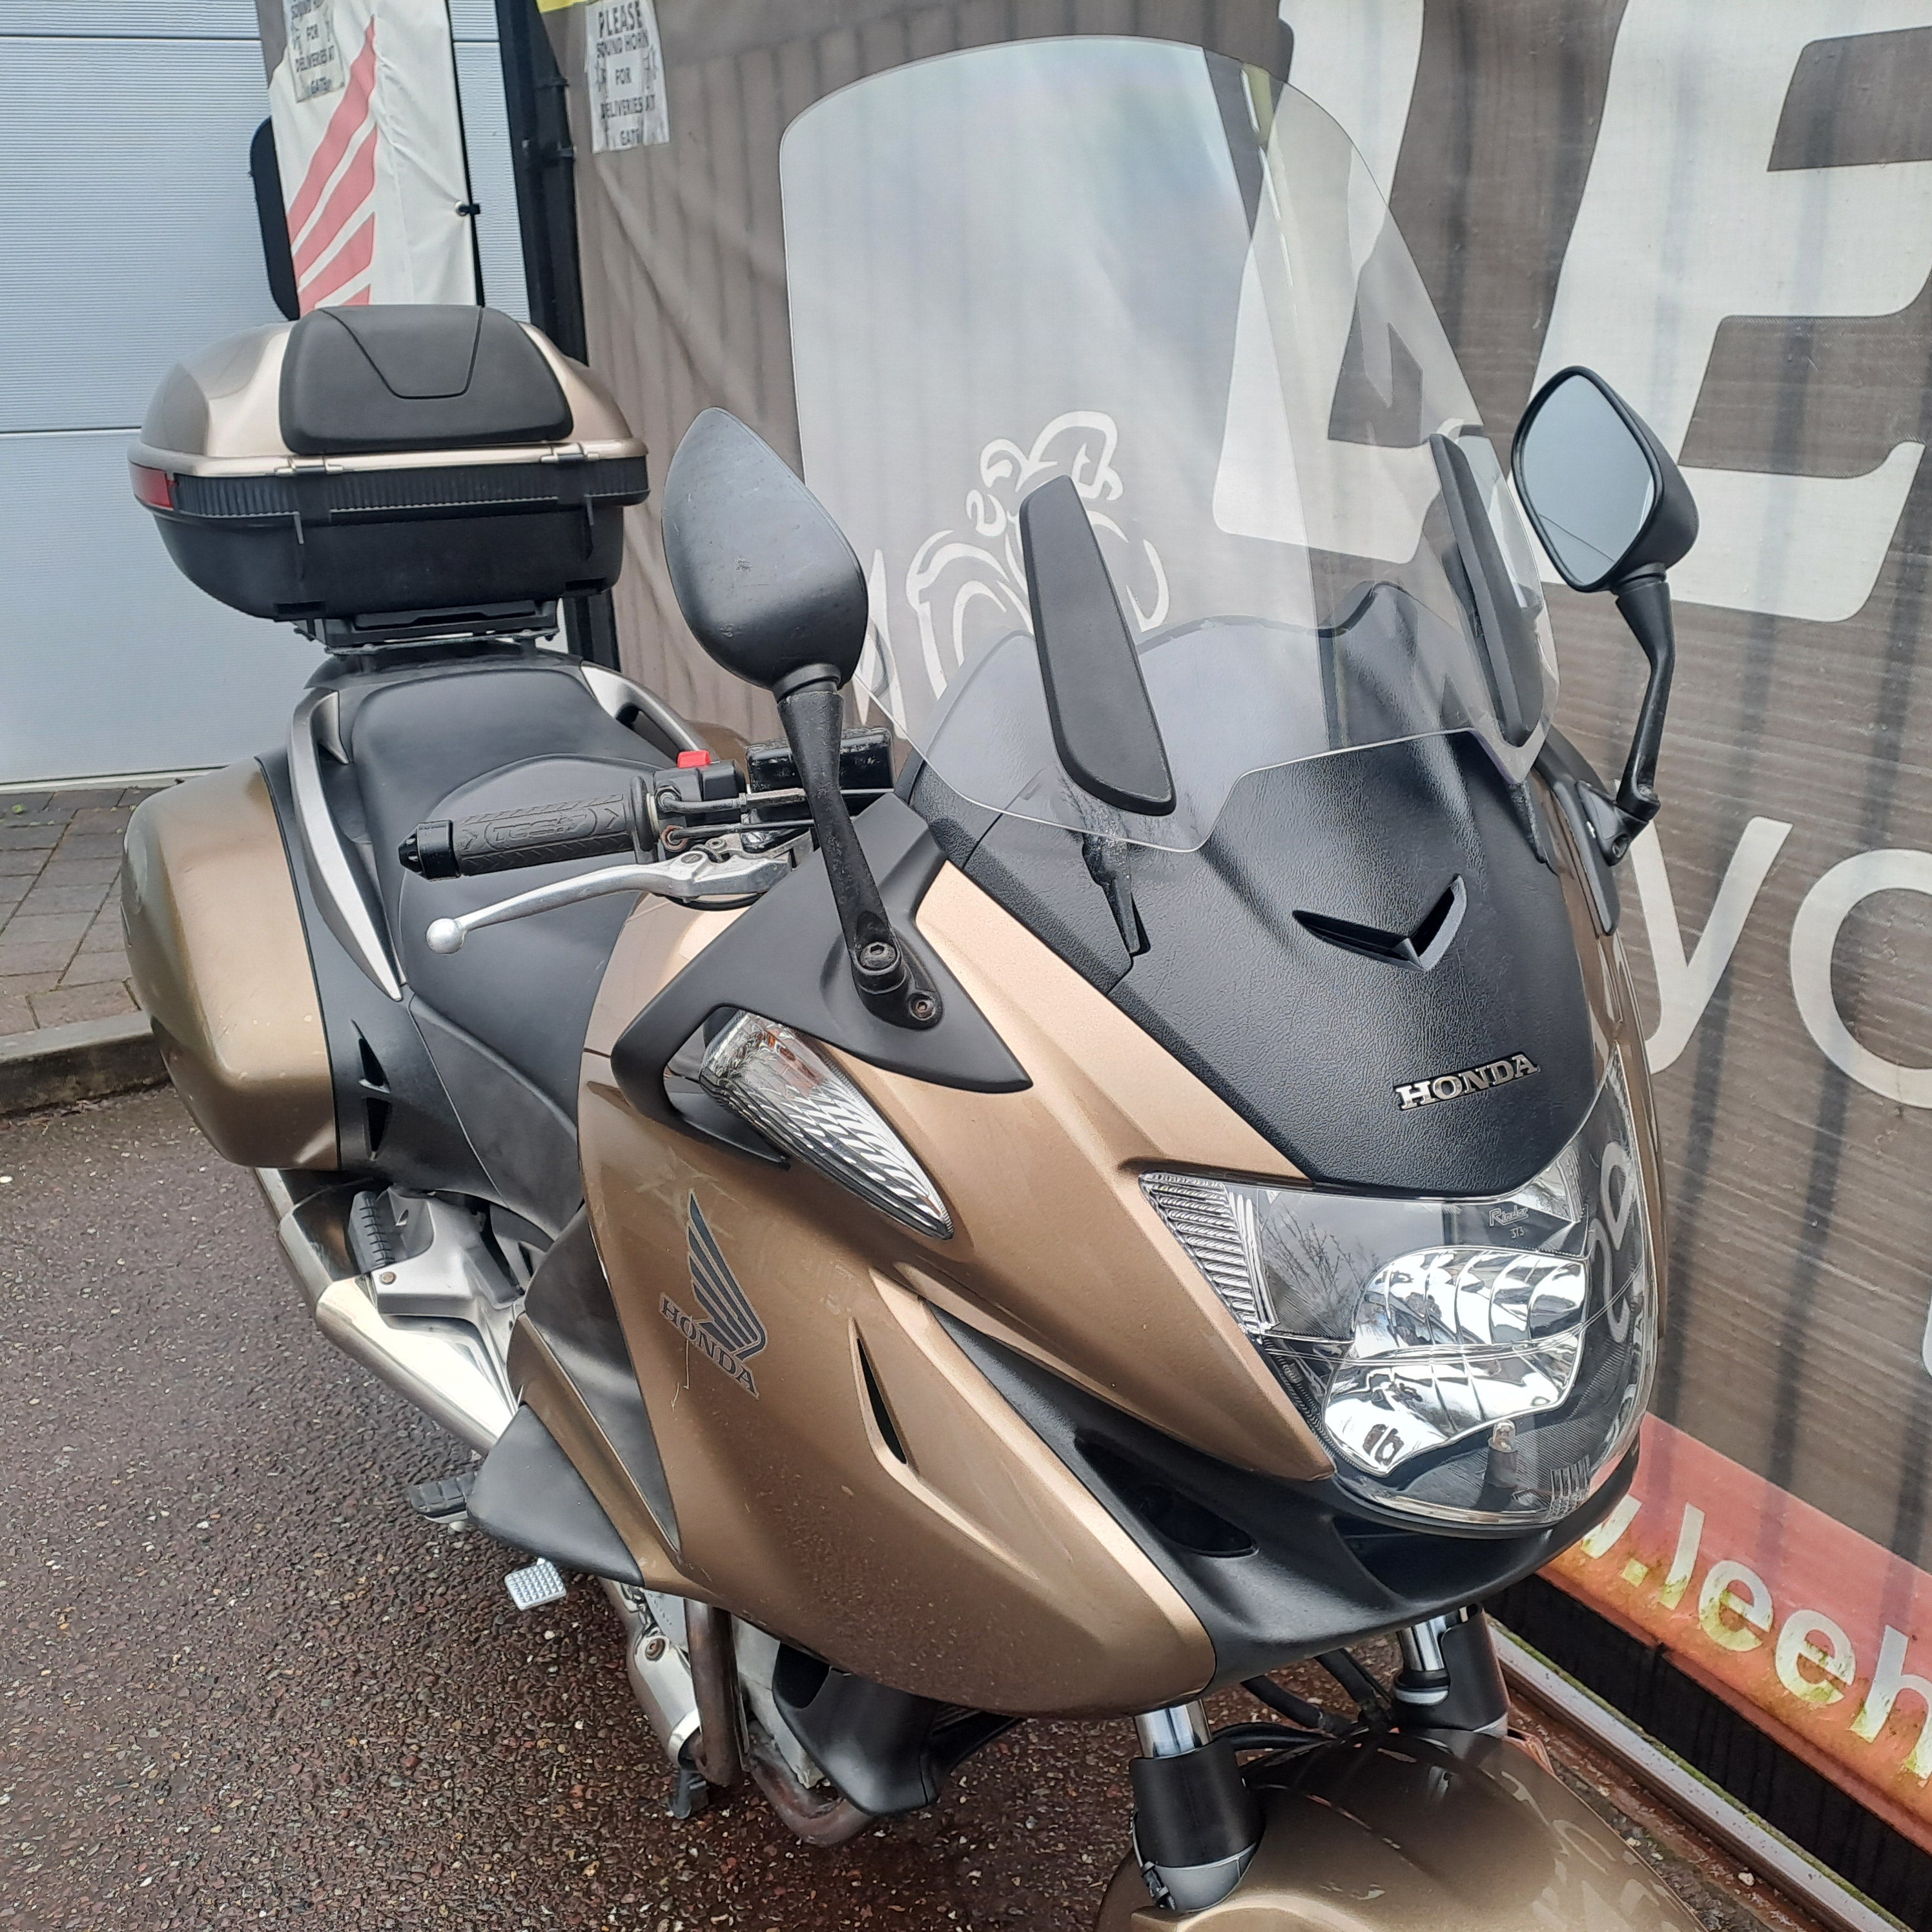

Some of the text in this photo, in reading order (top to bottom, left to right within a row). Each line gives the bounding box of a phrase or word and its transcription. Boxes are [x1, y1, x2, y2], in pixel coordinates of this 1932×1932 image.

[598, 0, 642, 38] PLEASE
[615, 67, 632, 85] FOR
[601, 97, 643, 119] DELIVERIES
[1395, 1053, 1539, 1109] HONDA
[660, 1297, 757, 1394] HONDA
